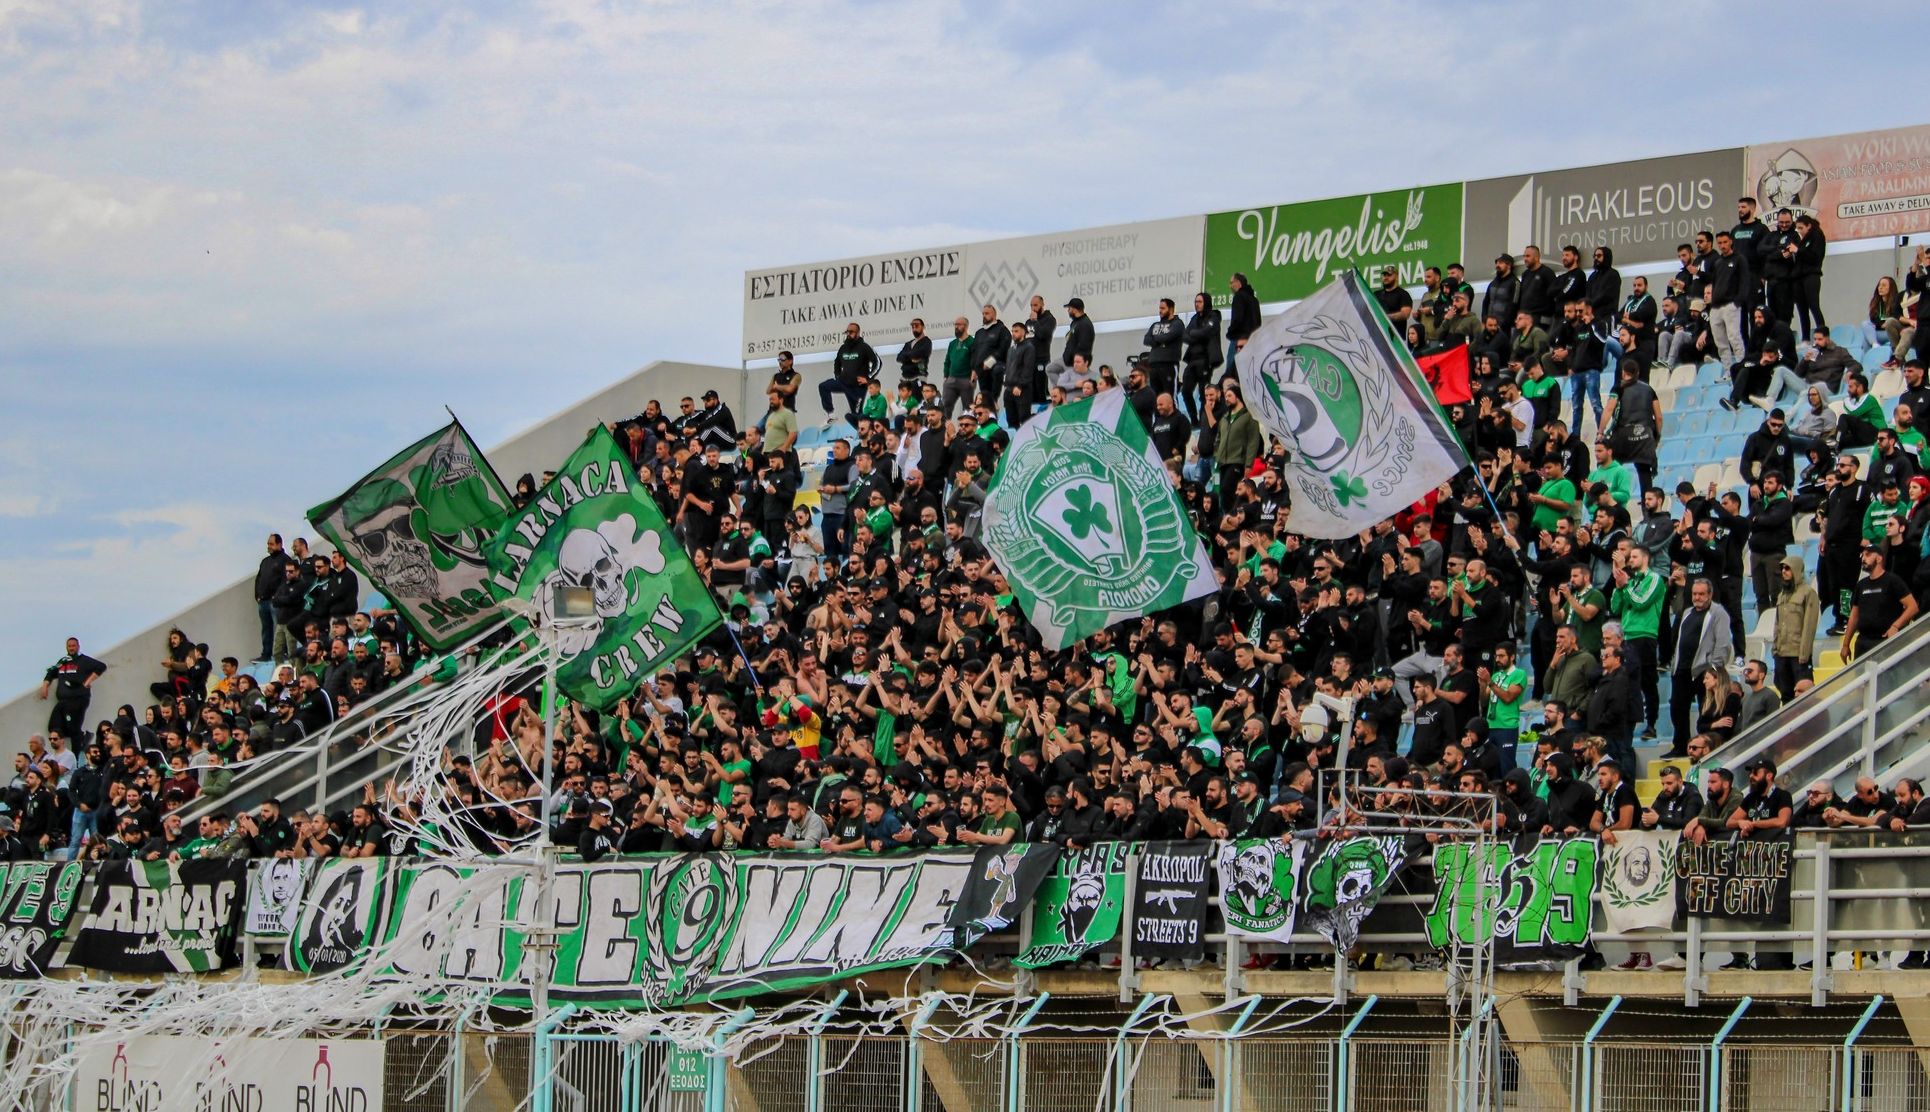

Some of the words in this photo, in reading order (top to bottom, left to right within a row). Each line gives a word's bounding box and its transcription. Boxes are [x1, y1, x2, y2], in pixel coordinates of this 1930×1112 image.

[1559, 178, 1714, 226] IRAKLEOUS
[1843, 205, 1866, 216] TAKE
[1868, 201, 1897, 213] AWAY
[1041, 233, 1140, 258] PHYSIOTHERAPY
[1236, 194, 1405, 284] Vangelis
[1556, 216, 1715, 251] CONSTRUCTIONS
[750, 262, 874, 301] ΕΣΤΙΑΤΟΡΙΟ
[880, 250, 961, 285] ΕΝΩΣΙΣ
[1057, 255, 1135, 278] CARDIOLOGY
[1071, 276, 1136, 298] AESTHETIC
[1138, 270, 1195, 291] MEDICINE
[780, 305, 816, 326] TAKE
[818, 301, 856, 321] AWAY
[859, 299, 870, 316] &
[874, 295, 907, 314] DINE
[910, 293, 926, 310] IN
[756, 339, 776, 354] +357
[778, 335, 815, 351] 23821352
[493, 460, 631, 595] LARNACA
[589, 593, 686, 690] CREW
[1735, 840, 1790, 878] NINE
[670, 861, 711, 921] GATE
[674, 883, 721, 956] 9
[722, 861, 972, 970] NINE
[1136, 917, 1187, 944] STREETS
[1188, 919, 1198, 944] 9
[1245, 912, 1286, 929] FANATICS
[97, 1078, 162, 1112] BLIND
[296, 1078, 368, 1112] BLIND
[671, 1074, 706, 1089] ΕΞΟΔΟΣ
